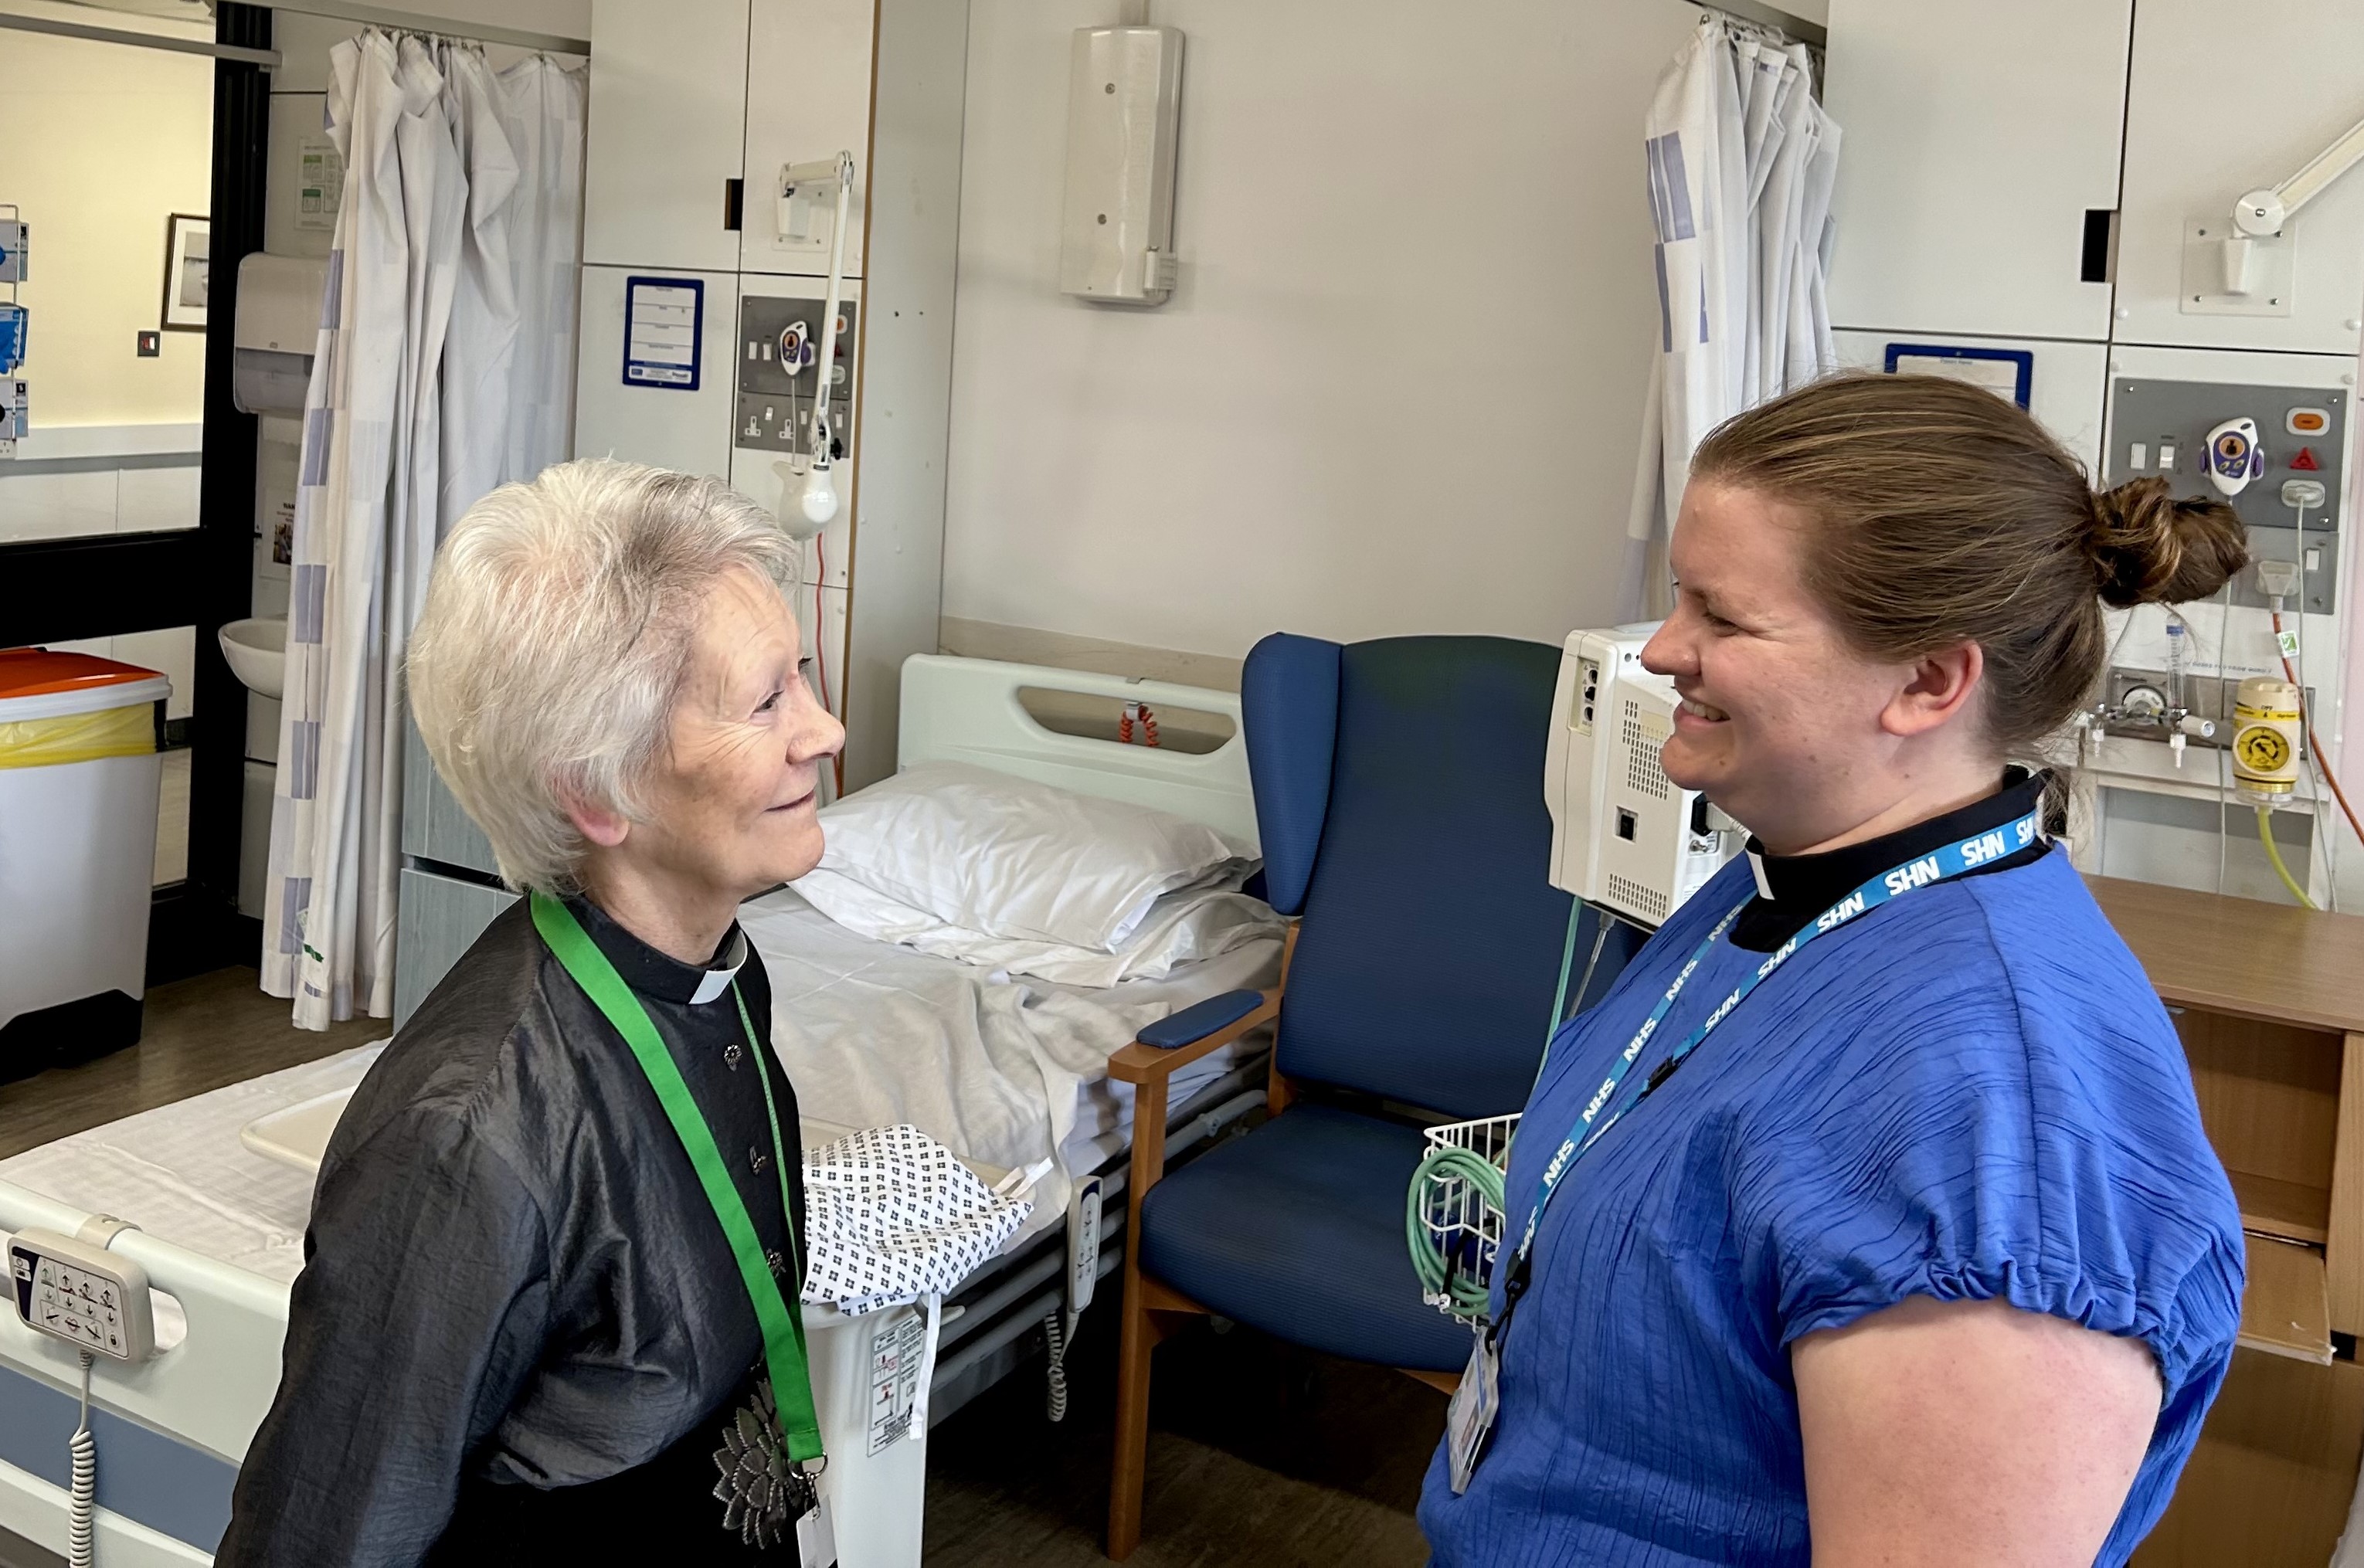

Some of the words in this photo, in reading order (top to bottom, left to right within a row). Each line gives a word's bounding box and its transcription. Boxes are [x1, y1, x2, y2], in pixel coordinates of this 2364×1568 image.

[1961, 831, 2006, 866] NHS
[1884, 856, 1941, 896] NHS
[1817, 892, 1865, 933] NHS
[1666, 959, 1698, 1001] NHS
[1758, 937, 1797, 980] NHS
[1705, 988, 1740, 1033] NHS
[1623, 1017, 1657, 1062] NHS
[1582, 1078, 1615, 1123] NHS
[1543, 1139, 1575, 1187] NHS
